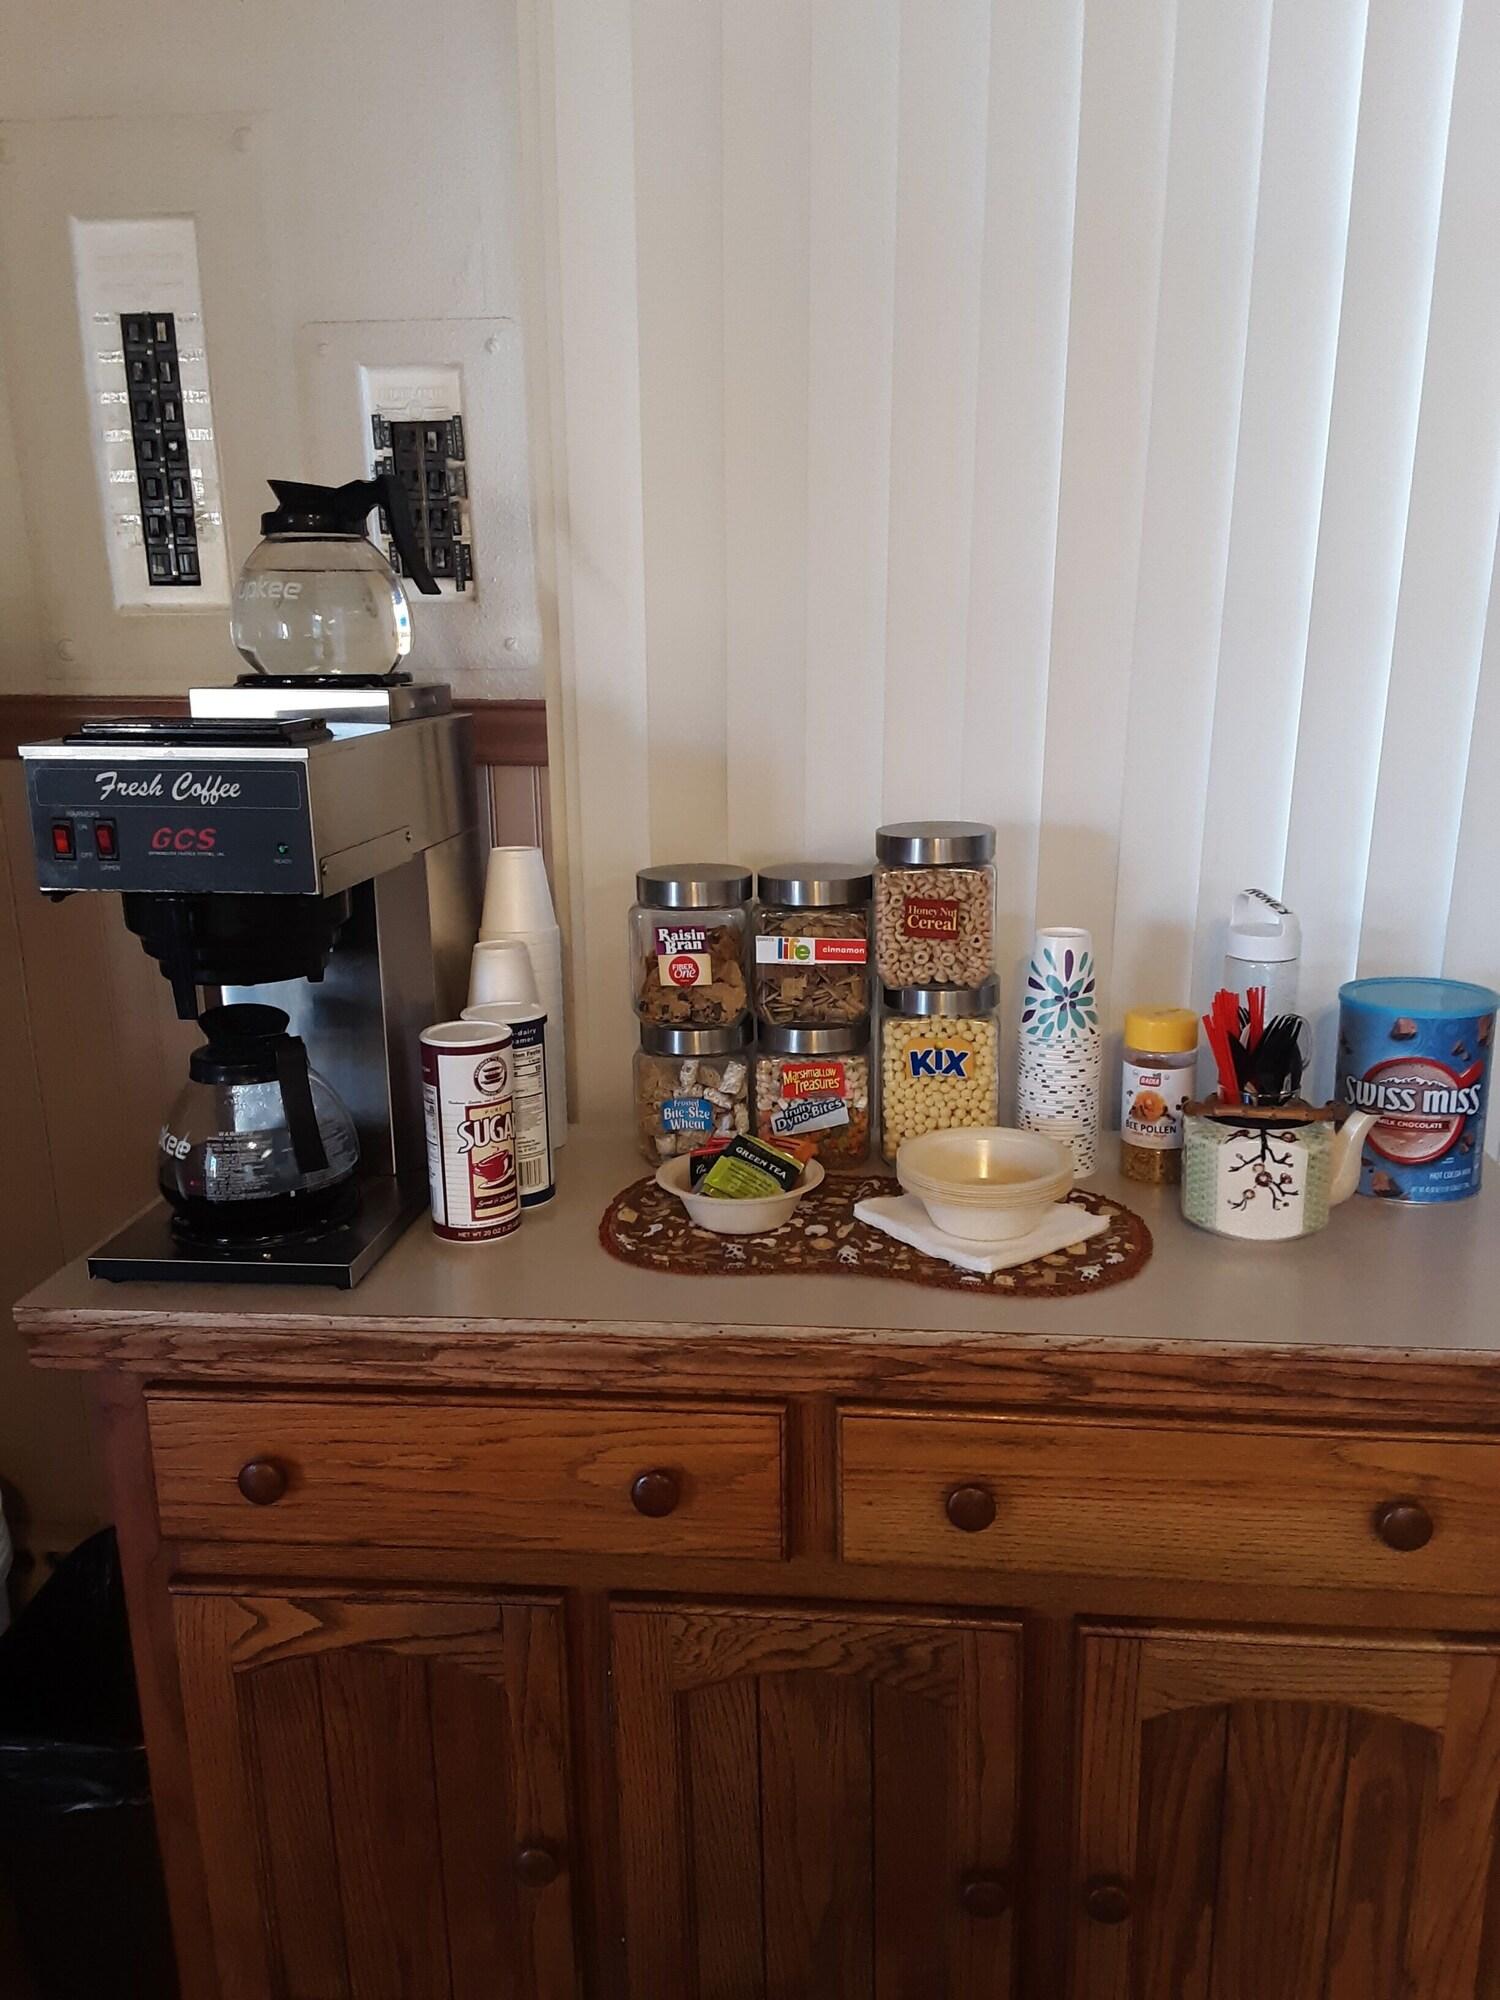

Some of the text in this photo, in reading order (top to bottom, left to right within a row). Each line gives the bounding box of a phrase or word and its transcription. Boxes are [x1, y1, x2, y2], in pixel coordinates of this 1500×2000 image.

[95, 771, 241, 805] Fresh Coffee
[151, 826, 217, 851] GCS
[908, 904, 937, 918] Honey
[907, 910, 957, 931] Cereal
[657, 928, 706, 943] Raisin
[664, 940, 703, 955] Bran
[777, 937, 811, 961] life
[822, 945, 865, 954] cinnamon
[512, 1028, 537, 1037] -dairy
[909, 1048, 971, 1079] KIX
[794, 1077, 841, 1096] Treasures
[775, 1099, 844, 1131] Dyno-Bites
[784, 1104, 812, 1119] fruity
[670, 1117, 705, 1131] Wheat
[1125, 1119, 1139, 1131] BEE
[1140, 1124, 1177, 1134] POLLEN
[1396, 1120, 1443, 1129] CHOCOLATE
[456, 1111, 517, 1154] SUGA
[735, 1146, 768, 1168] GREEN
[768, 1162, 788, 1181] TEA
[492, 1227, 501, 1235] OZ
